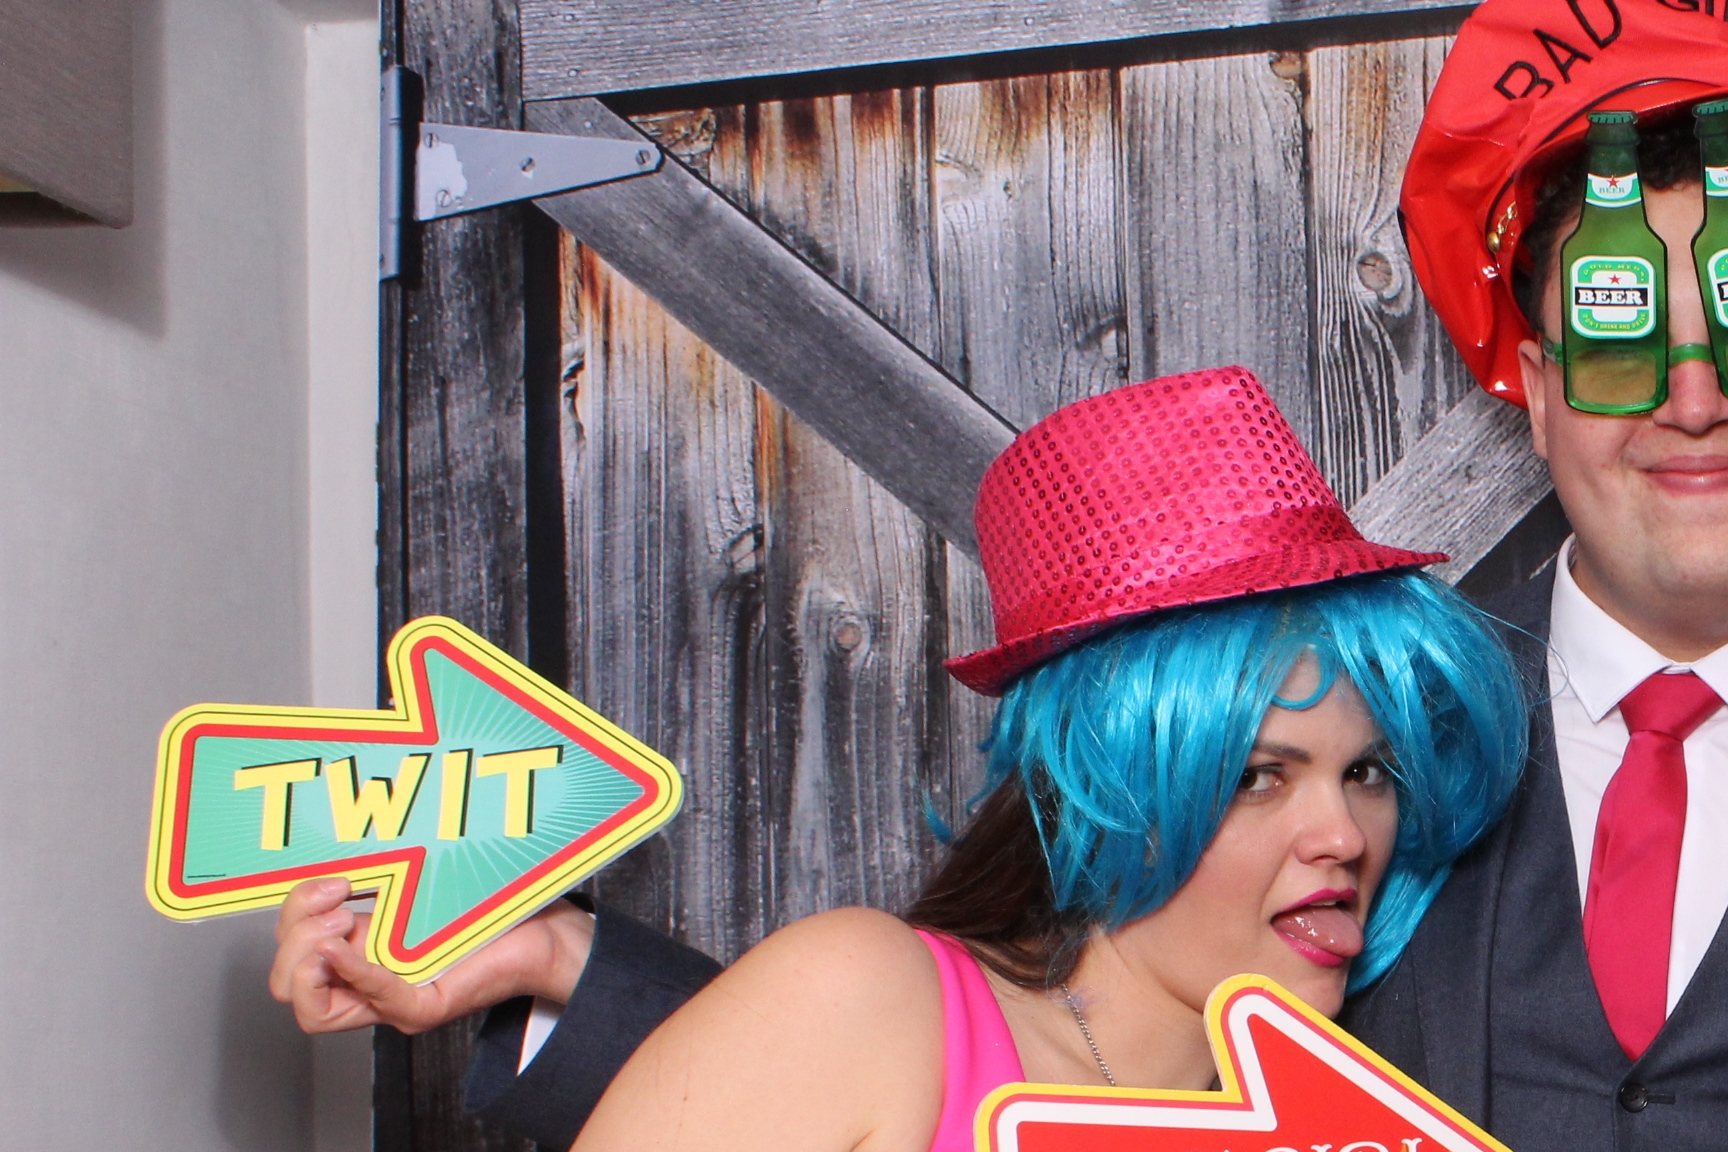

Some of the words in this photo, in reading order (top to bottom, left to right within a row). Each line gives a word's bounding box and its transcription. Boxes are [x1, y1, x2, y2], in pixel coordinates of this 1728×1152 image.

[1493, 0, 1622, 101] BAD
[1578, 289, 1644, 305] BEER
[233, 744, 564, 852] TWIT
